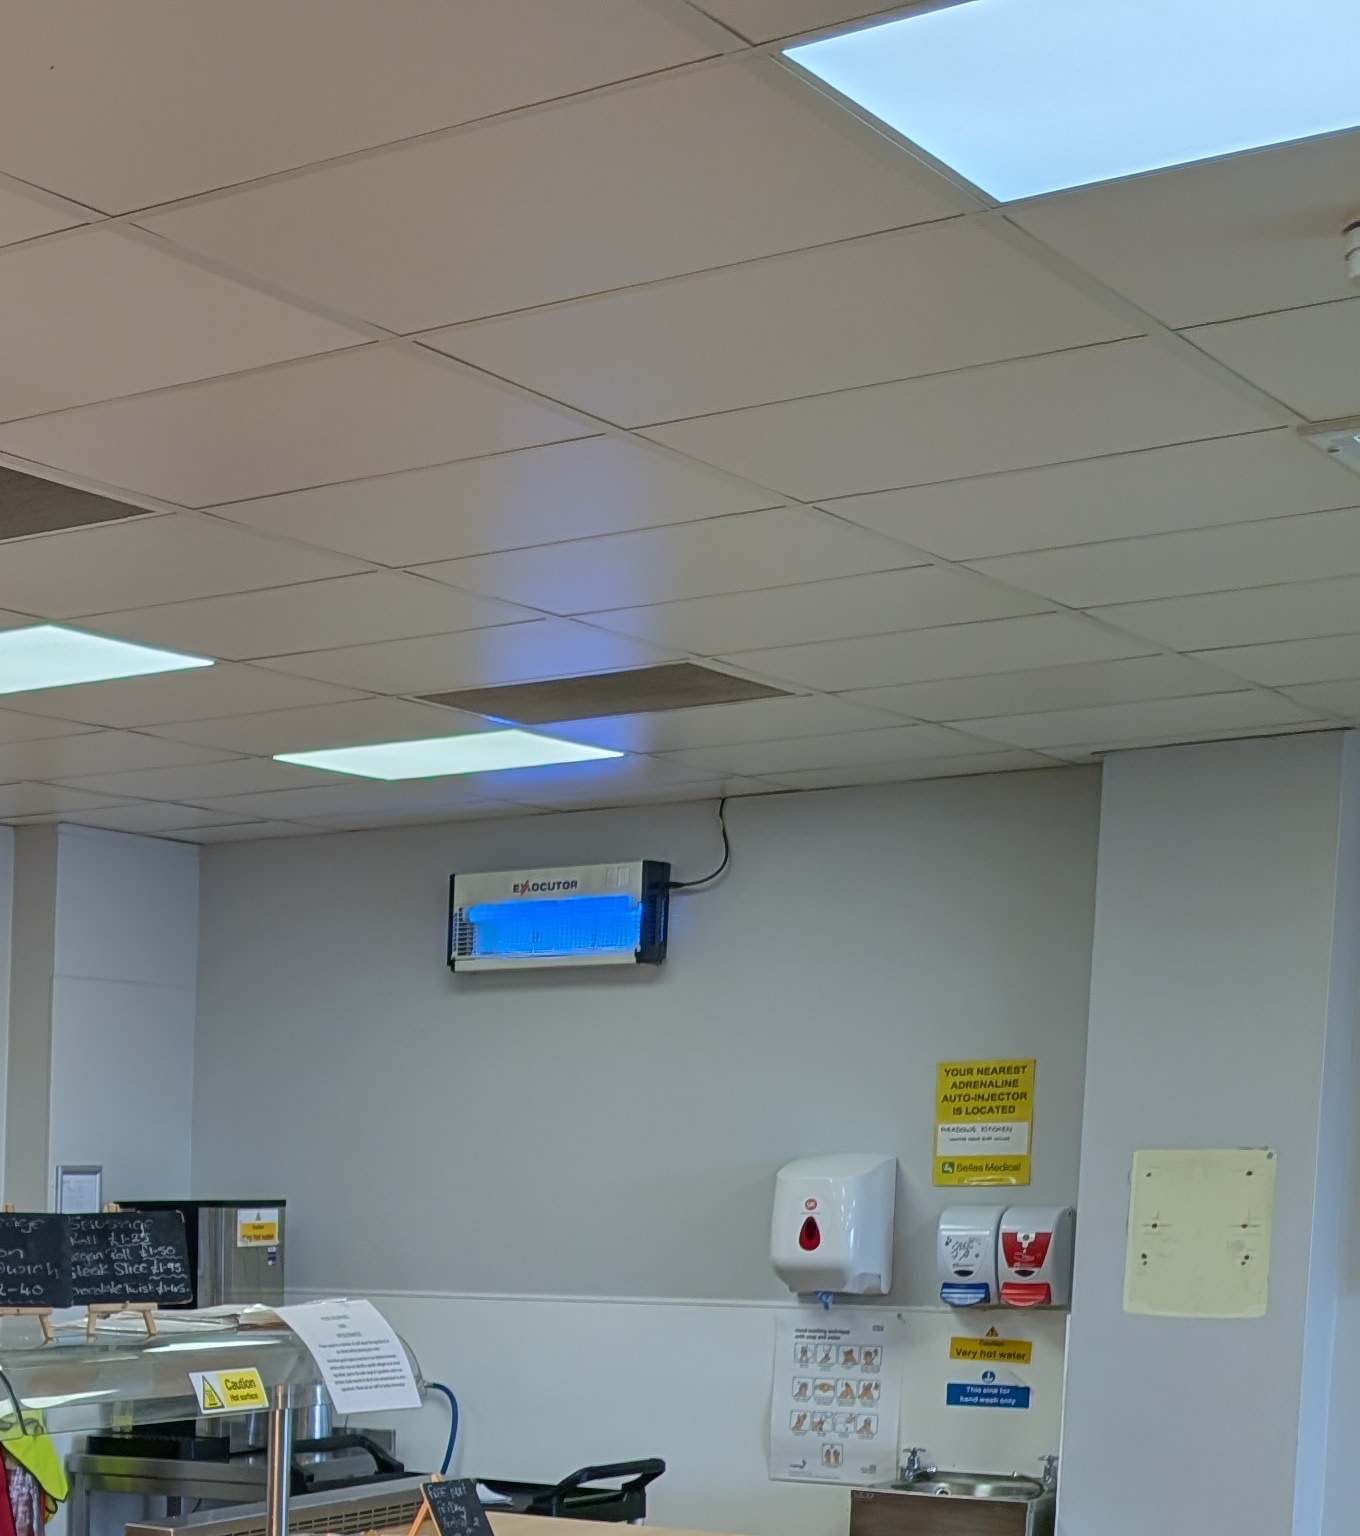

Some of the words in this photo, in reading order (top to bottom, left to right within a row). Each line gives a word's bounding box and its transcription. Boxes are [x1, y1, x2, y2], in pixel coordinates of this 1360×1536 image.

[944, 1067, 973, 1077] YOUR
[976, 1065, 1027, 1075] NEAREST
[950, 1079, 1019, 1090] ADRENALINE
[941, 1092, 1028, 1103] AUTO-INJECTOR
[952, 1107, 962, 1116] IS
[965, 1105, 1016, 1115] LOCATED
[955, 1348, 977, 1359] Very
[980, 1349, 997, 1358] hot
[999, 1352, 1026, 1360] water
[224, 1377, 256, 1391] Caution
